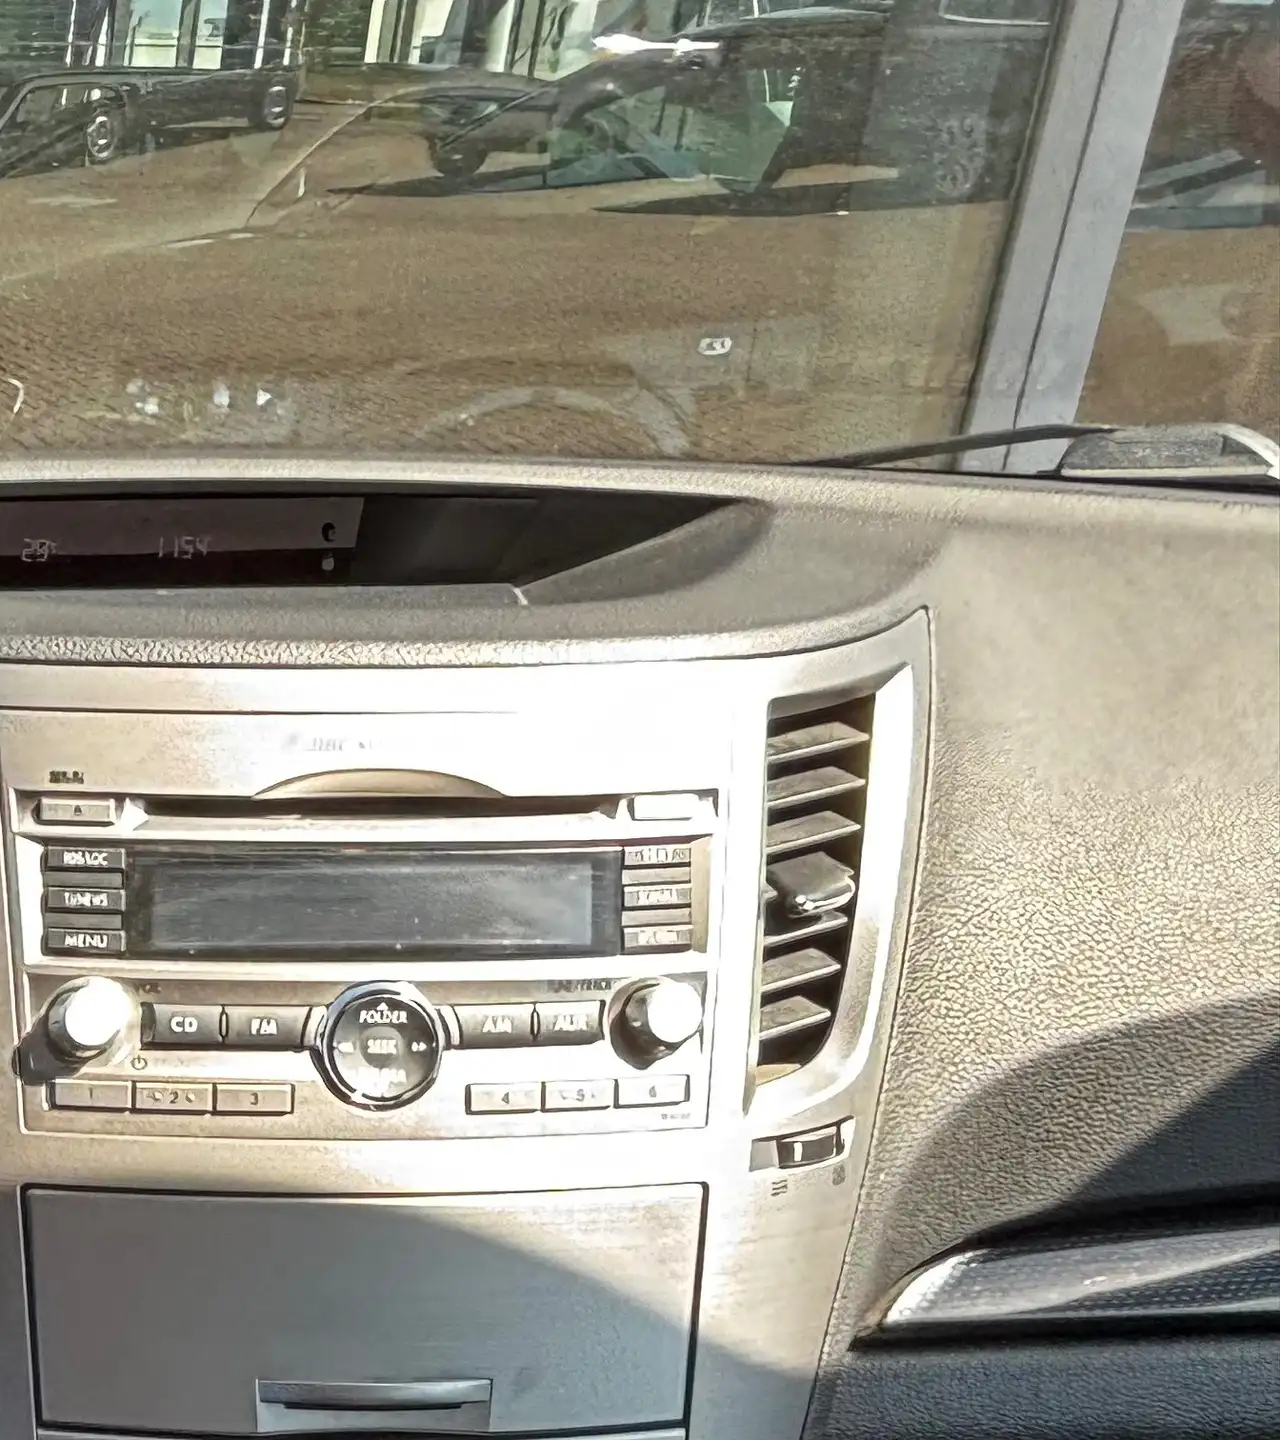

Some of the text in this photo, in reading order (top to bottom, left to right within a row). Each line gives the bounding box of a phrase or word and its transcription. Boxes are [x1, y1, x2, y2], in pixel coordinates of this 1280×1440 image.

[64, 934, 108, 949] MENU
[359, 1009, 408, 1024] FOLDER
[170, 1015, 198, 1034] CD
[250, 1016, 279, 1037] FM
[482, 1015, 513, 1034] AM
[168, 1090, 180, 1105] 2
[249, 1091, 260, 1106] 3
[501, 1091, 511, 1105] 4
